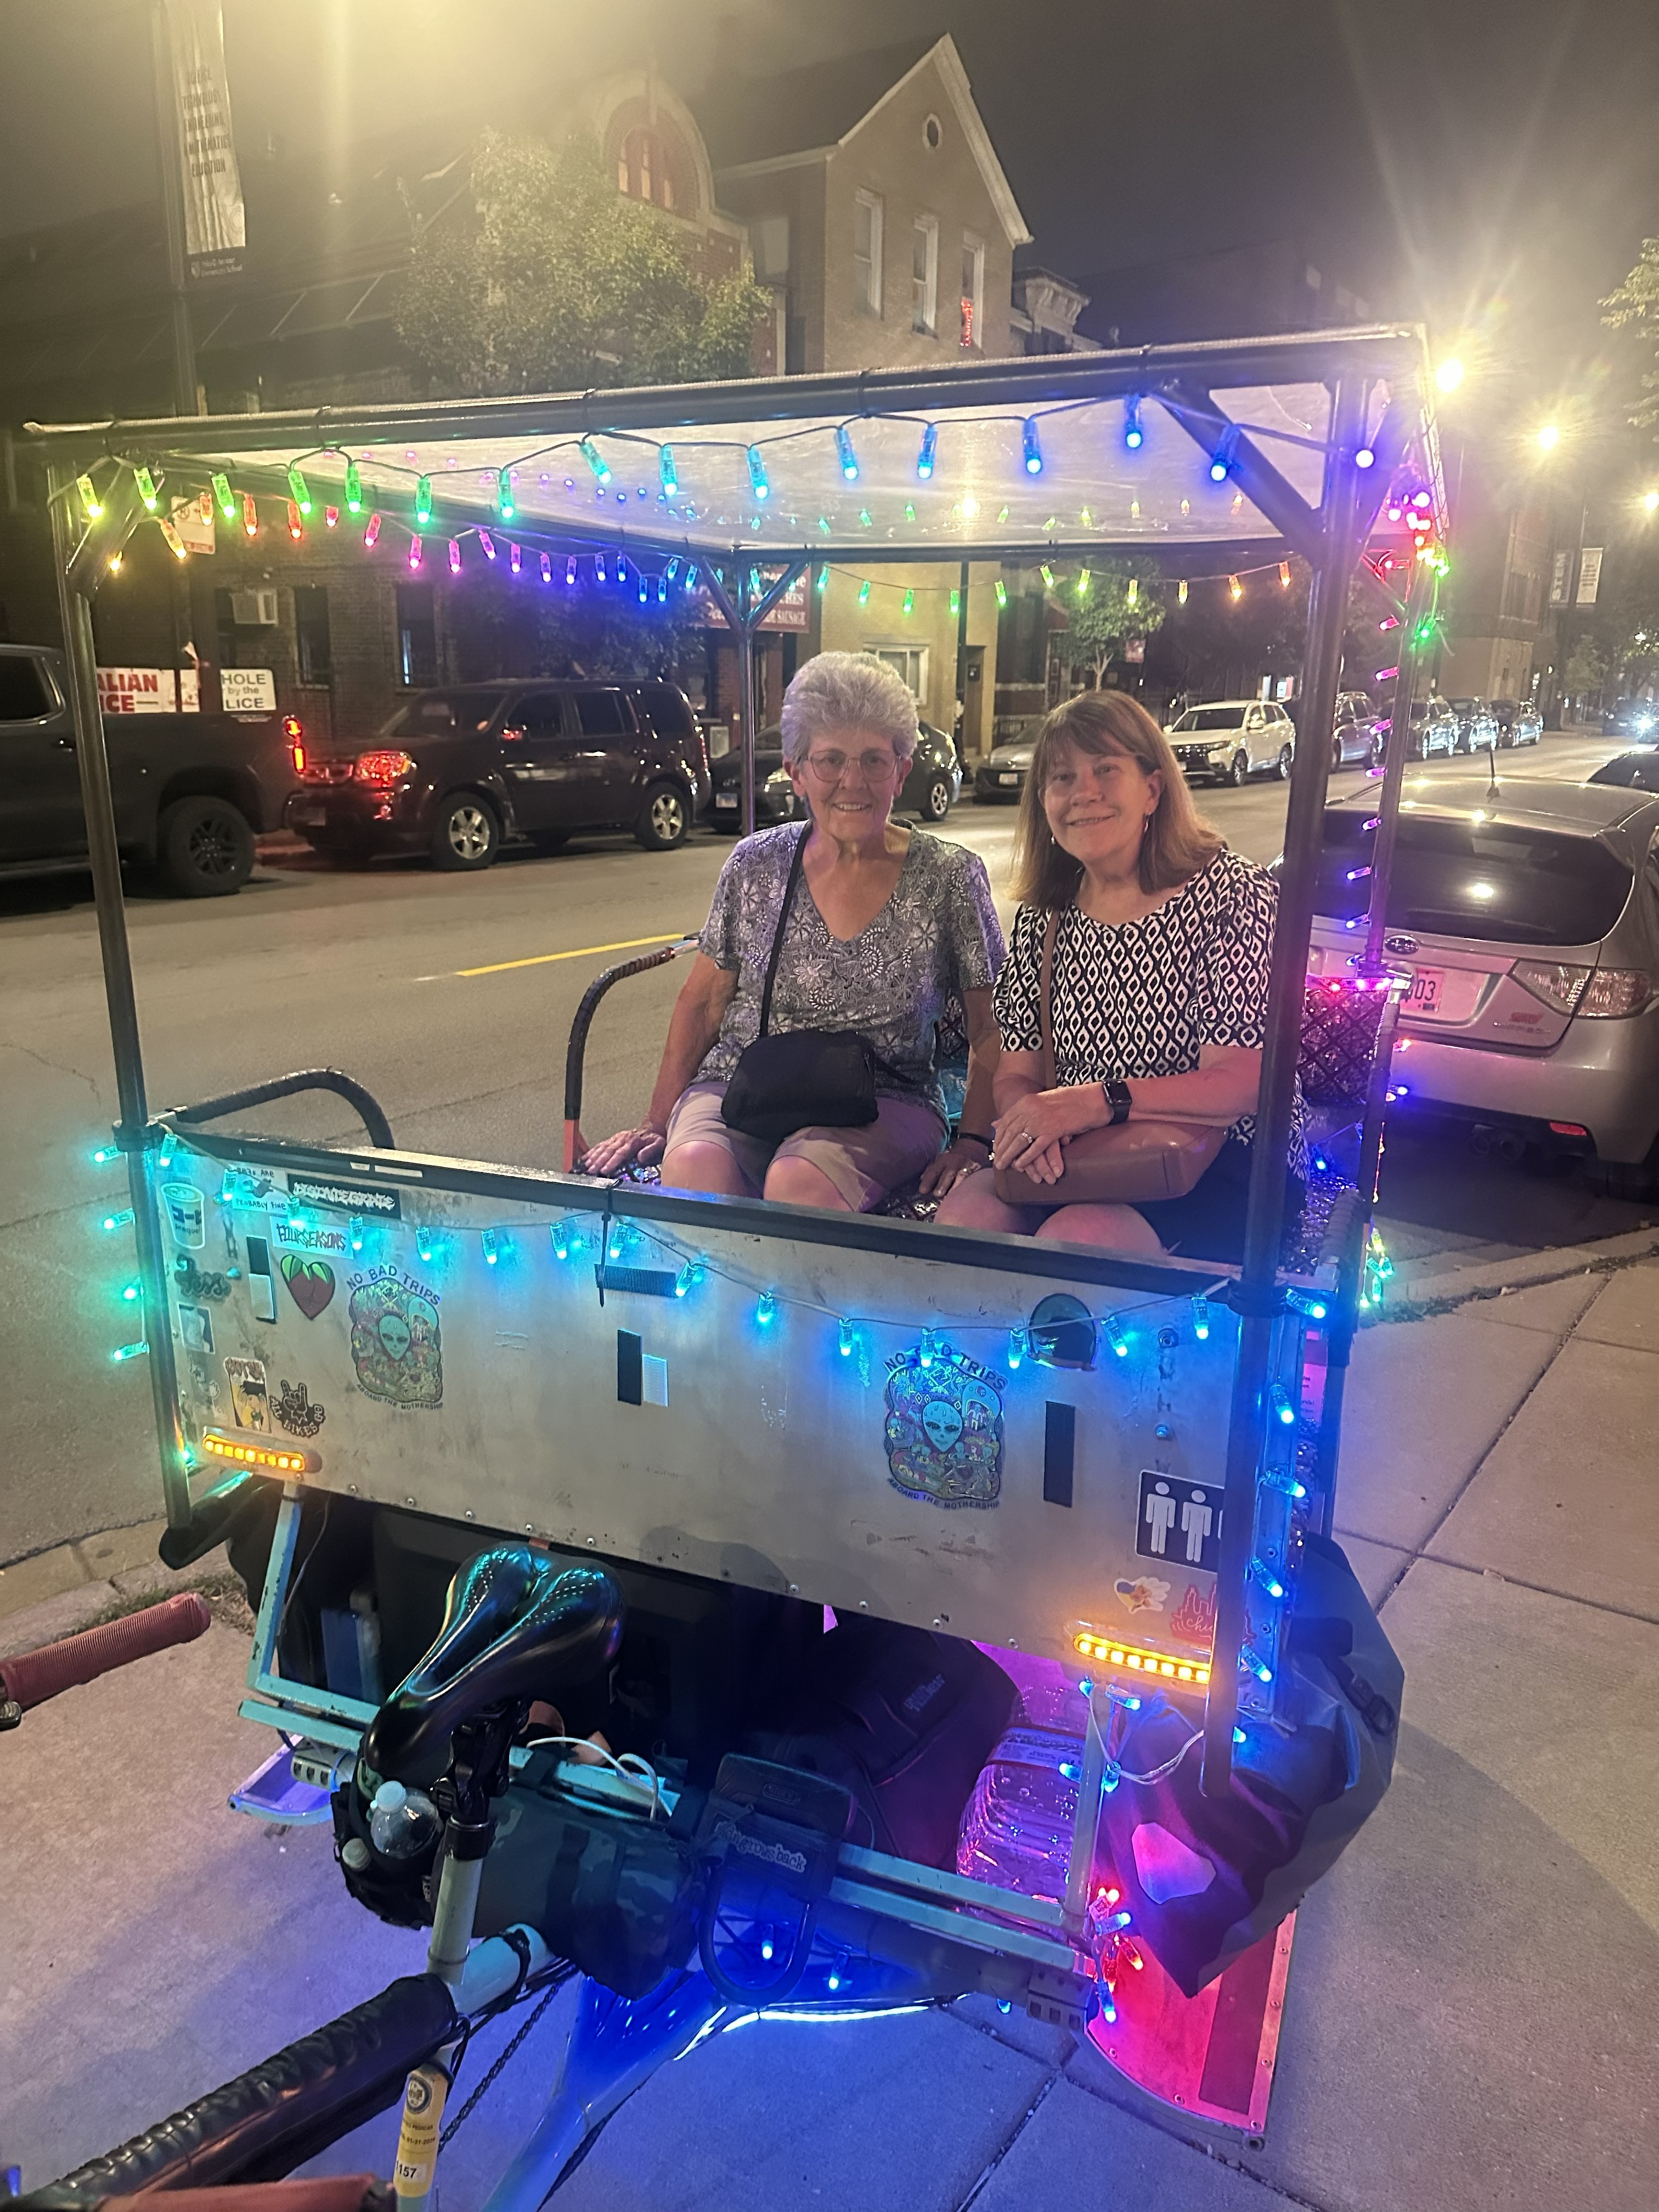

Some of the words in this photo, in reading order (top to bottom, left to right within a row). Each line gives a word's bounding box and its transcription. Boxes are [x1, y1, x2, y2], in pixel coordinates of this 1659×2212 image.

[97, 674, 158, 692] ALIAN
[221, 674, 266, 685] HOLE
[225, 698, 265, 709] LICE
[235, 1198, 268, 1210] PROBABLY
[347, 1273, 363, 1289] NO
[369, 1265, 397, 1280] BAD
[403, 1273, 441, 1305] TRIPS
[884, 1353, 906, 1372] NO
[960, 1352, 1007, 1390] TRIPS
[357, 1384, 382, 1402] ABOARD
[384, 1398, 398, 1407] THE
[270, 1397, 283, 1418] ALL
[314, 1405, 324, 1422] GO
[888, 1479, 919, 1499] ABOARD
[923, 1494, 940, 1505] THE
[944, 1501, 1000, 1509] MOTHERSHIP
[776, 1846, 804, 1870] back
